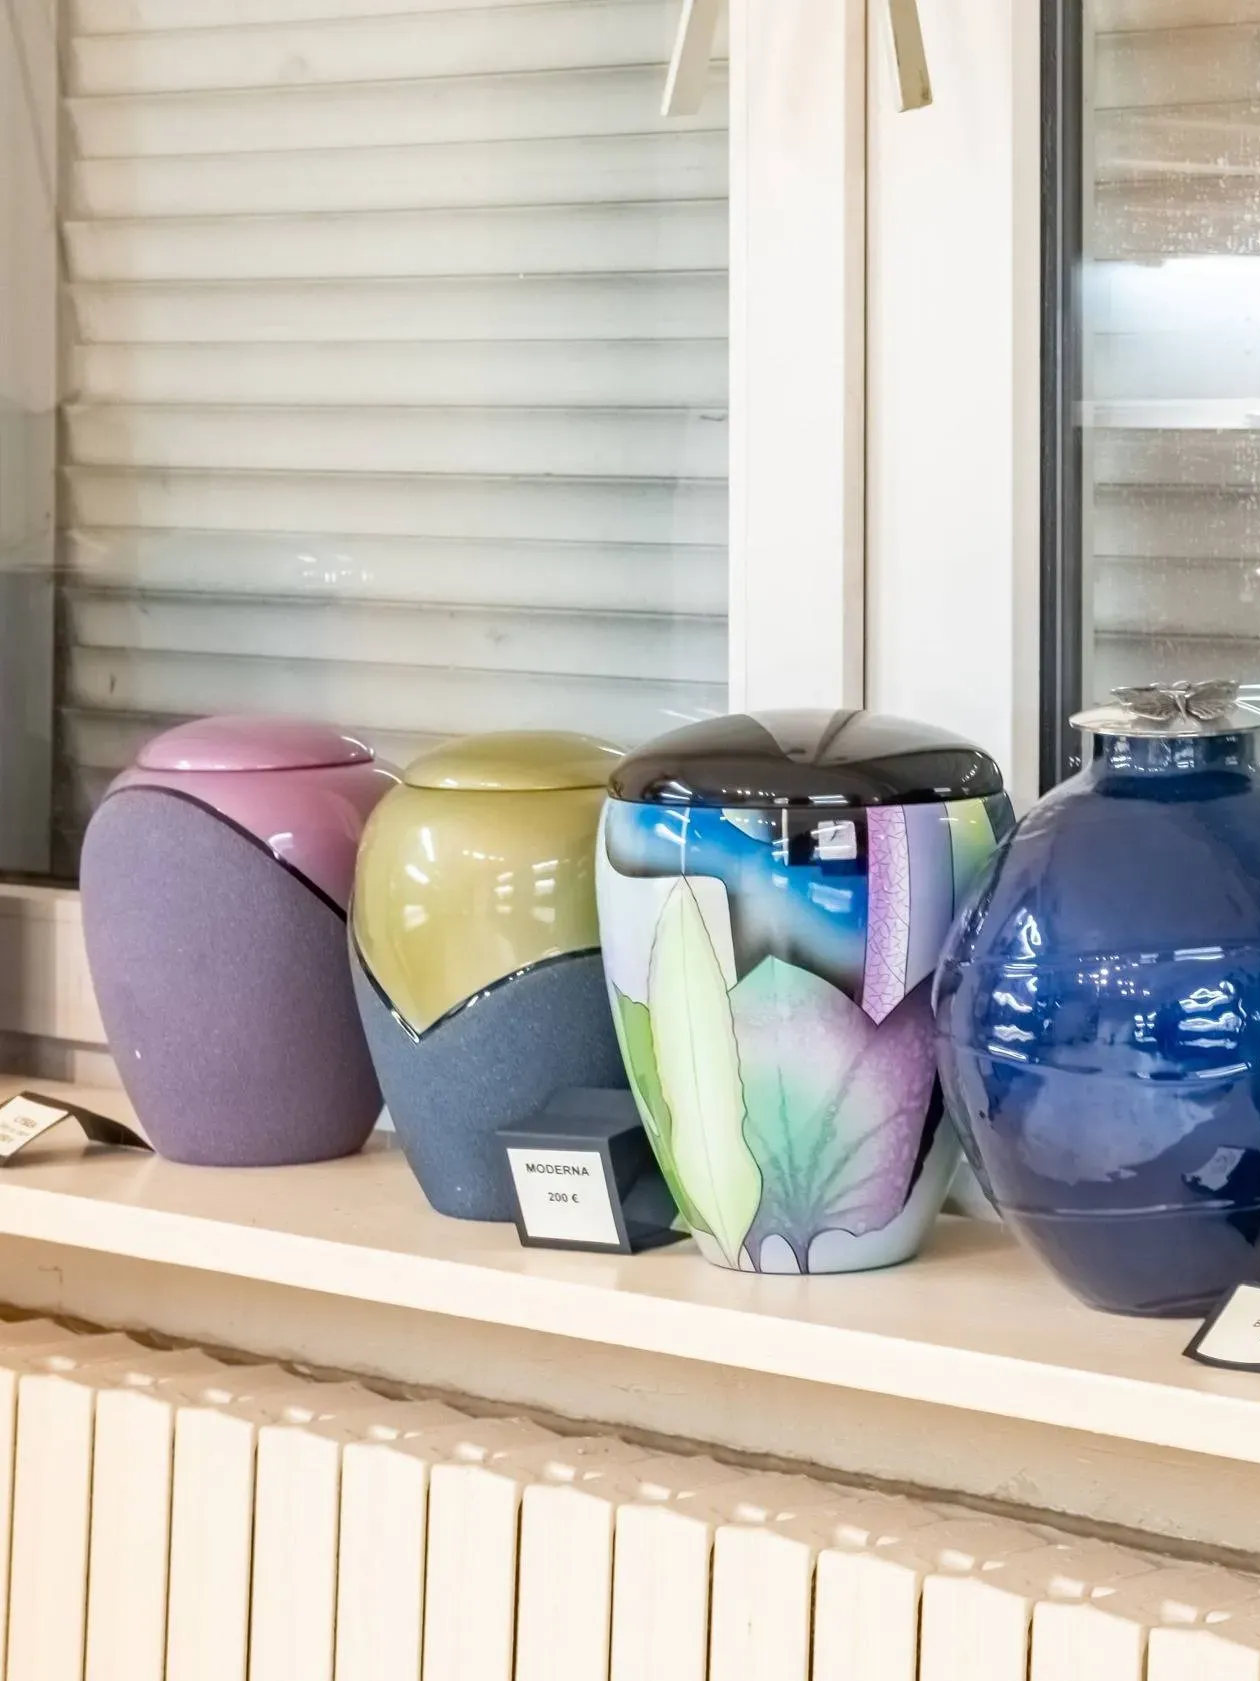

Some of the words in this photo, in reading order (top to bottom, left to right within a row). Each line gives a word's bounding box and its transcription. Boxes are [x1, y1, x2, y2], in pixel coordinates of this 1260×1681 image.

[525, 1163, 590, 1176] MODERNA
[548, 1192, 568, 1203] 200
[571, 1193, 580, 1203] €
